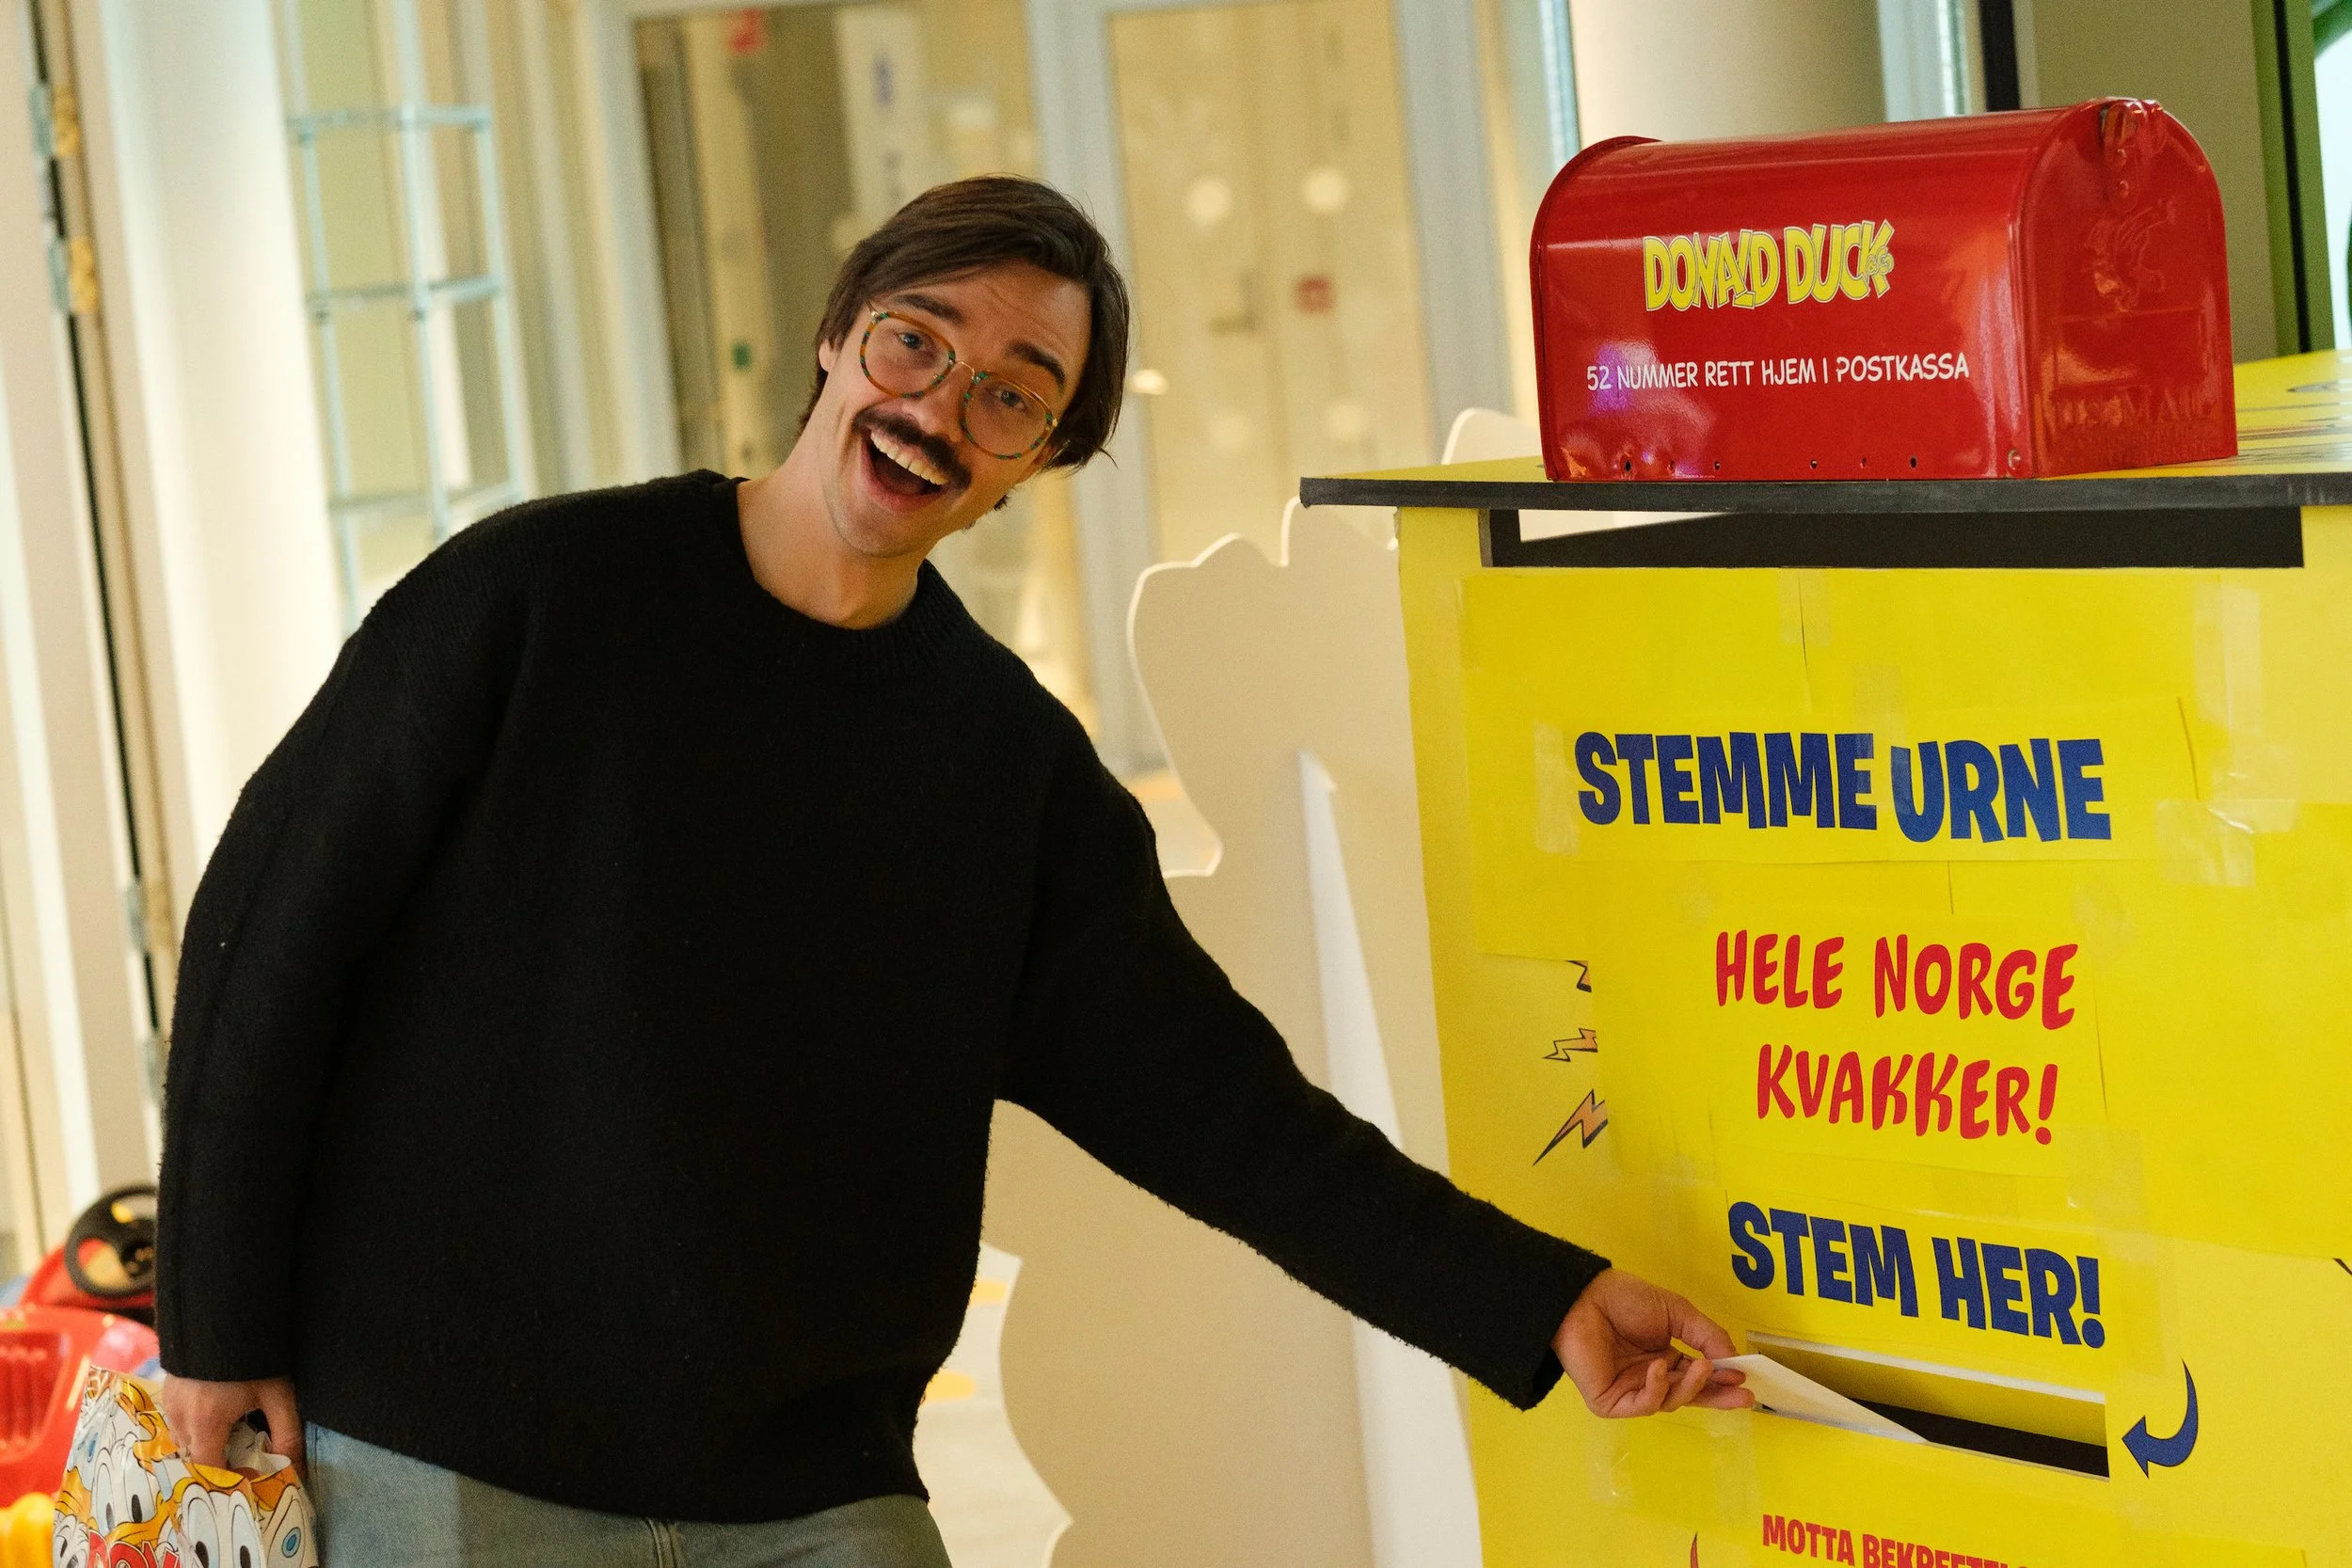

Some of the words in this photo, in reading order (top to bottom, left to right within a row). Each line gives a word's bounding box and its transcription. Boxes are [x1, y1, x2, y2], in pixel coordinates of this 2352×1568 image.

[1643, 229, 1780, 312] DONALD
[1784, 218, 1895, 305] DUCK
[1586, 365, 1612, 390] 52
[1617, 361, 1698, 389] NUMMER
[1705, 360, 1755, 387] RETT
[1761, 357, 1817, 386] HJEM
[1822, 356, 1829, 384] I
[1836, 352, 1970, 383] POSTKASSA
[1575, 732, 1878, 831] STEMME
[1889, 737, 2112, 843] URNE
[1716, 929, 1845, 1010] HELE
[1874, 933, 2079, 1031] NORGE
[1756, 1044, 2058, 1146] KVAKKER!
[1728, 1201, 1919, 1318] STEM
[1932, 1237, 2106, 1349] HER!
[1762, 1513, 1855, 1566] MOTTA
